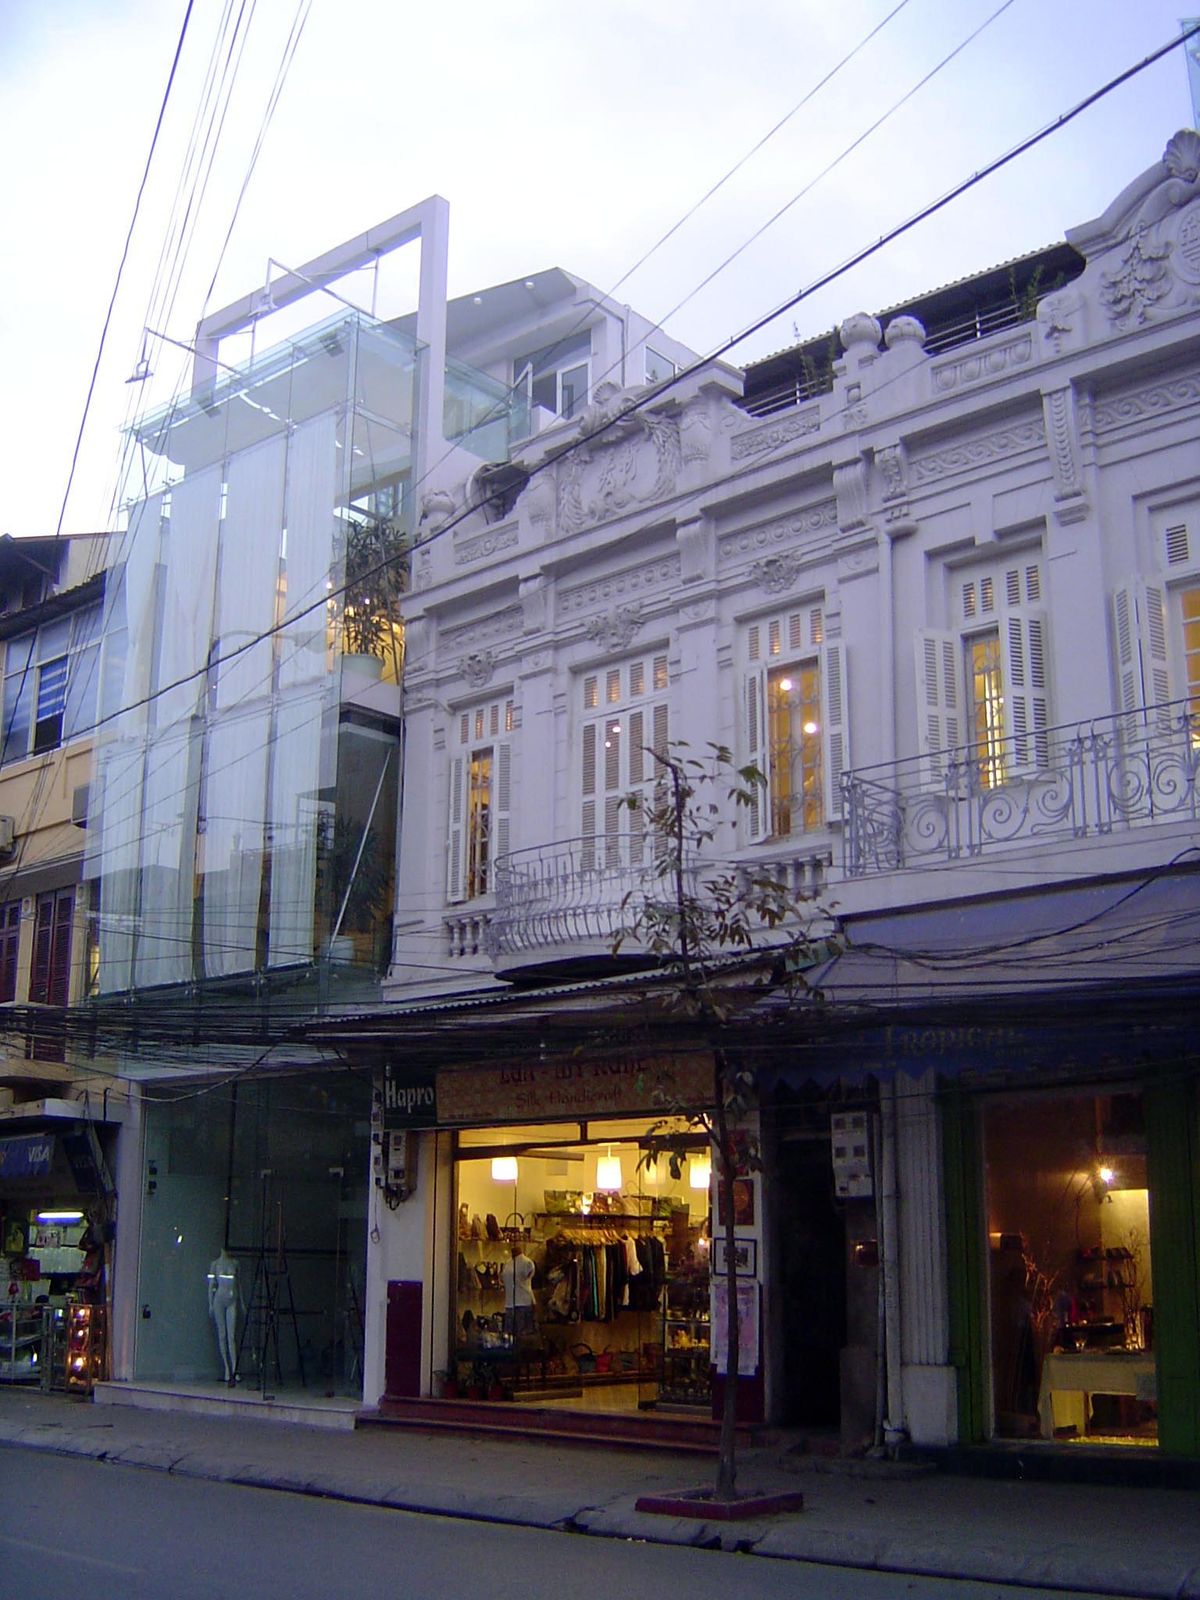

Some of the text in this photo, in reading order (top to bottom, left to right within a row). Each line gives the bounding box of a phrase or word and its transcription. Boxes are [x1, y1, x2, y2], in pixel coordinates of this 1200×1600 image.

[385, 1078, 435, 1114] Hapro
[516, 1087, 541, 1108] Silk
[28, 1145, 50, 1163] VISA
